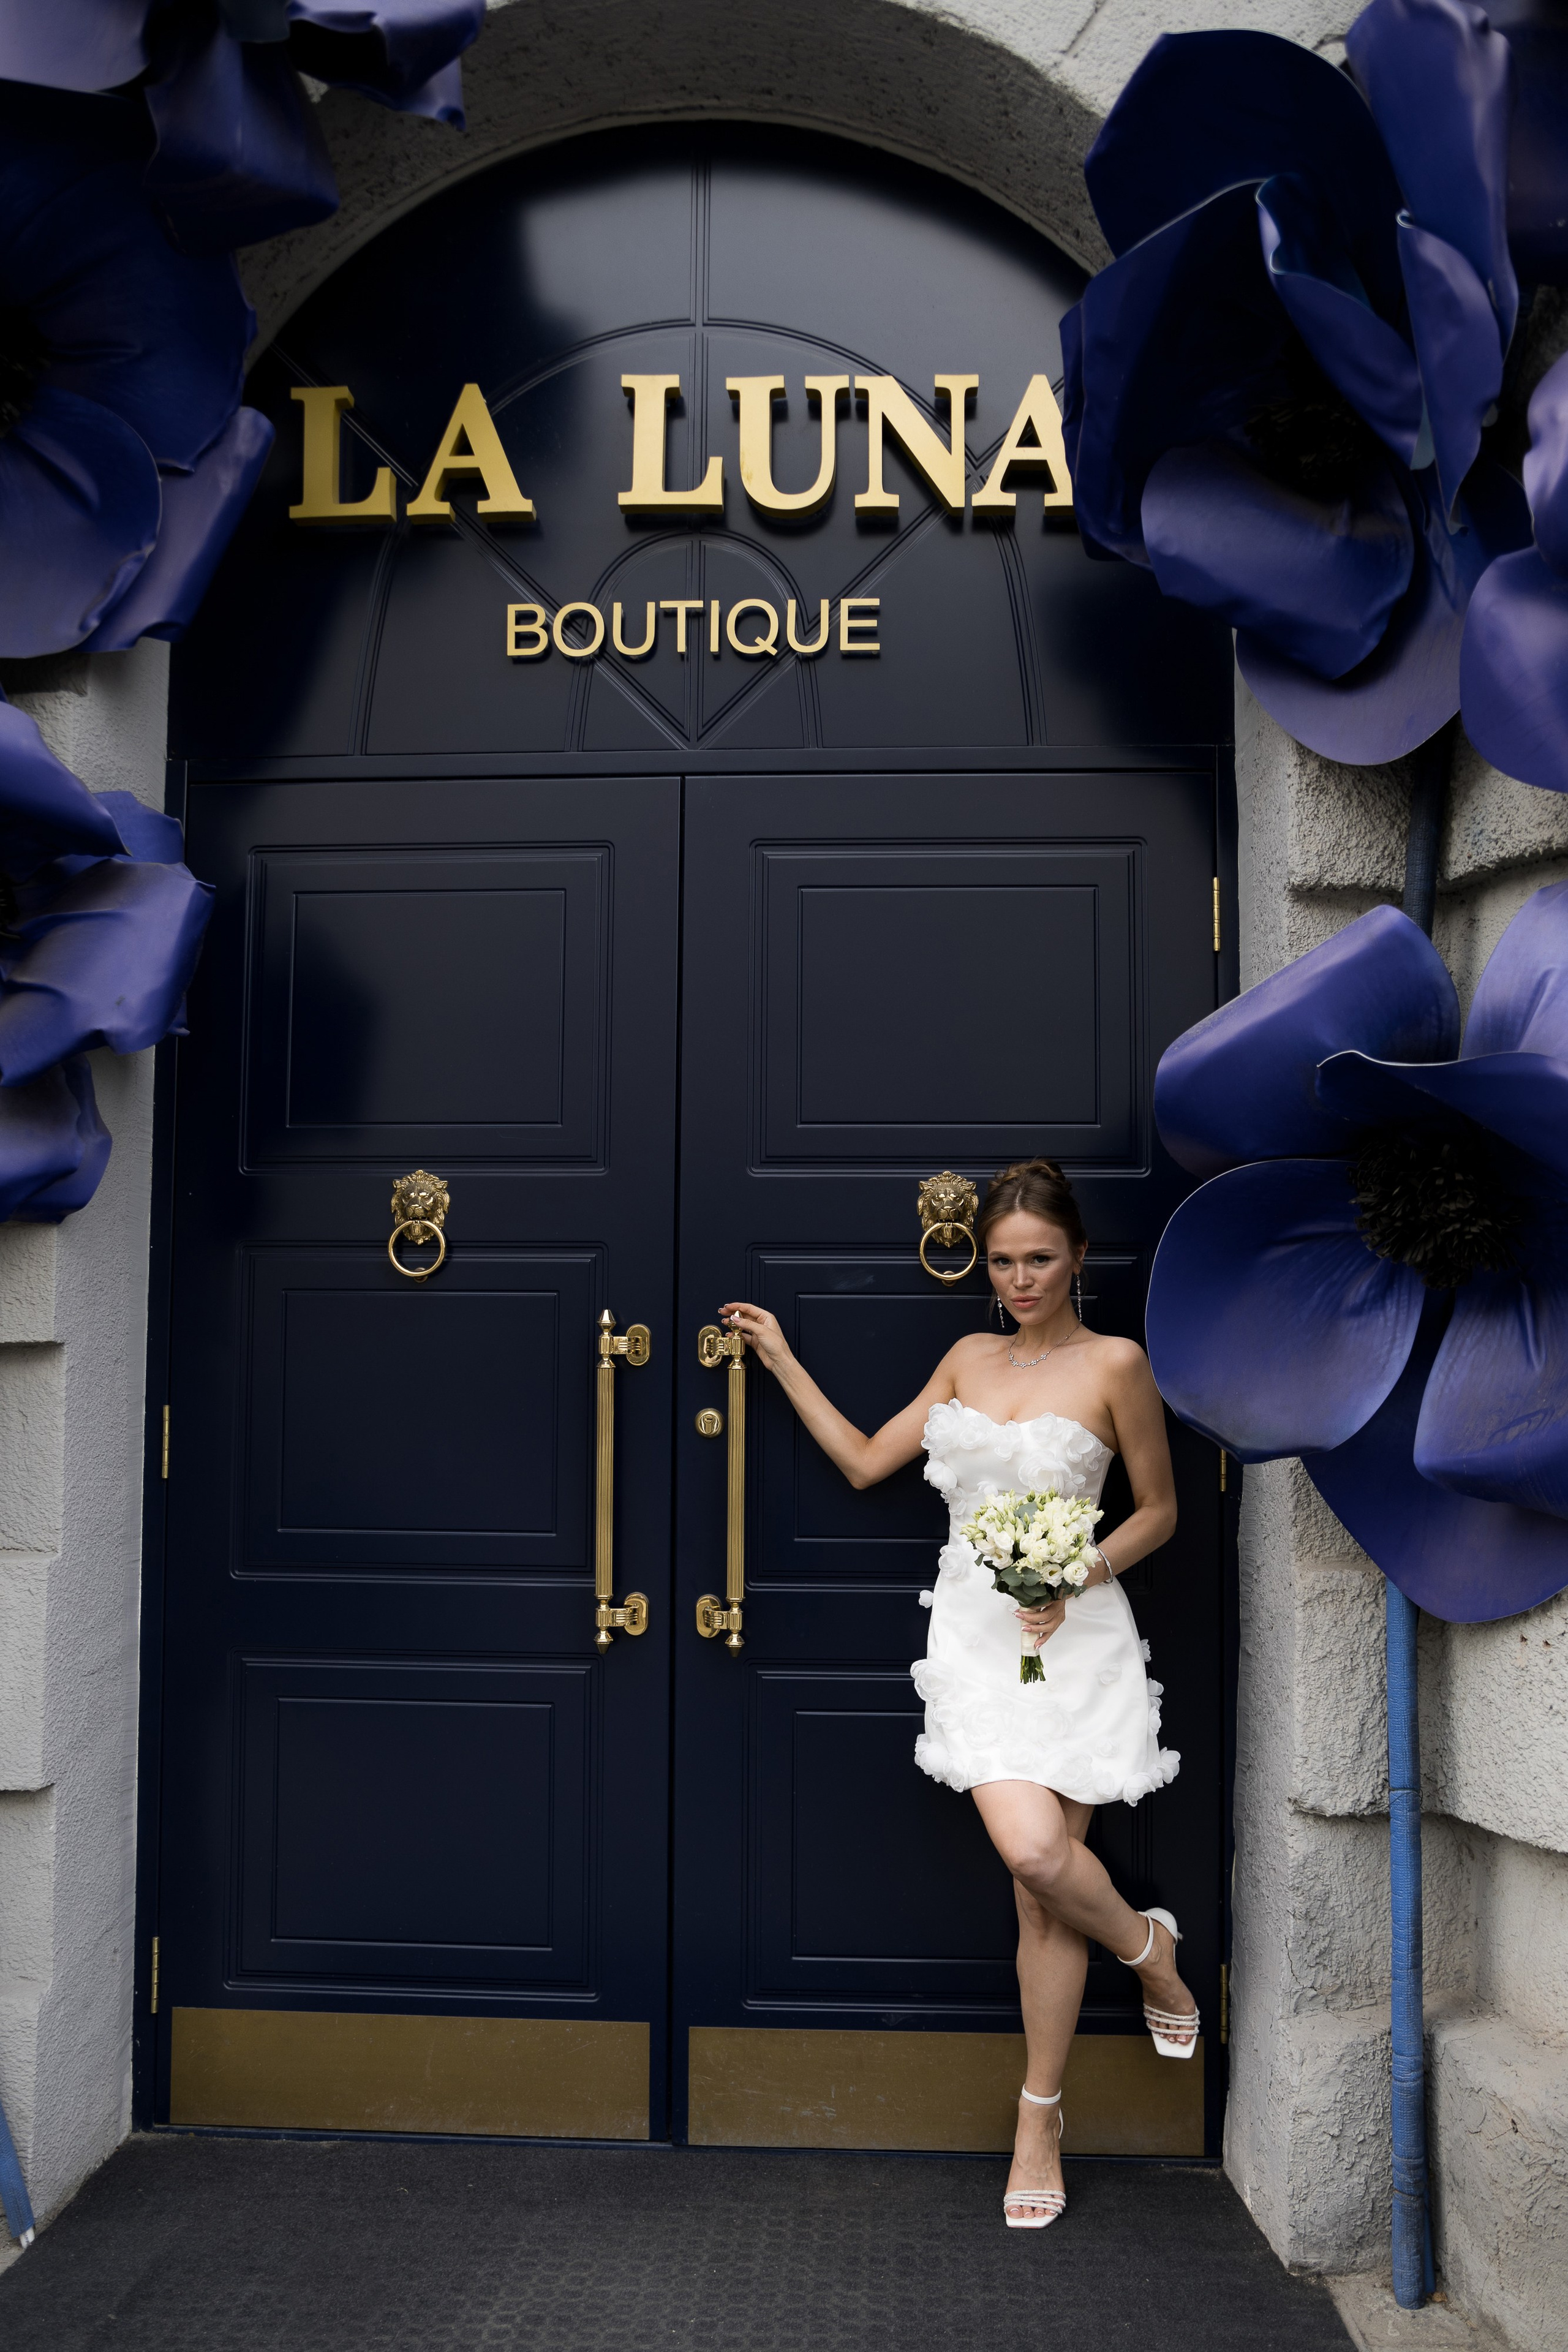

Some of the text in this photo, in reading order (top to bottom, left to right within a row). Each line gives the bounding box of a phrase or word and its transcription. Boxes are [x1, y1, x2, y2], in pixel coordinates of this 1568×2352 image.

[289, 374, 1073, 525] LA LUNA
[506, 598, 881, 657] BOUTIQUE
